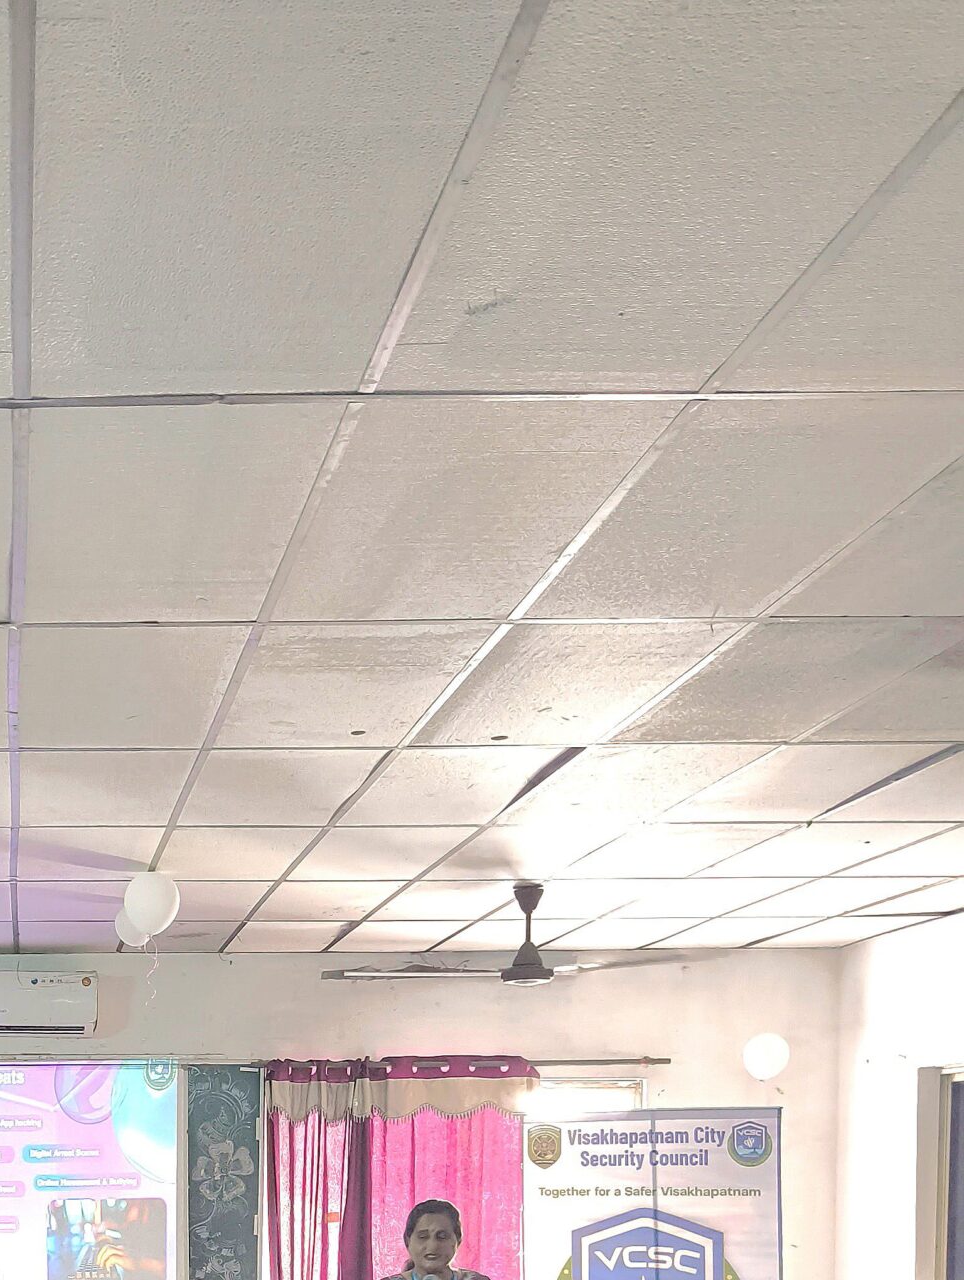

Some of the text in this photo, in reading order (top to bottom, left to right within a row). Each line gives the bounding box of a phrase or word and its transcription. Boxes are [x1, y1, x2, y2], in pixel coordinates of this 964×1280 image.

[568, 1127, 725, 1148] Visakhapatnam City
[580, 1149, 708, 1170] Security Council
[539, 1187, 590, 1198] Together
[595, 1187, 609, 1196] for
[624, 1187, 656, 1196] Safer
[661, 1187, 761, 1198] Visakhapatnam
[594, 1245, 701, 1274] VCSC
